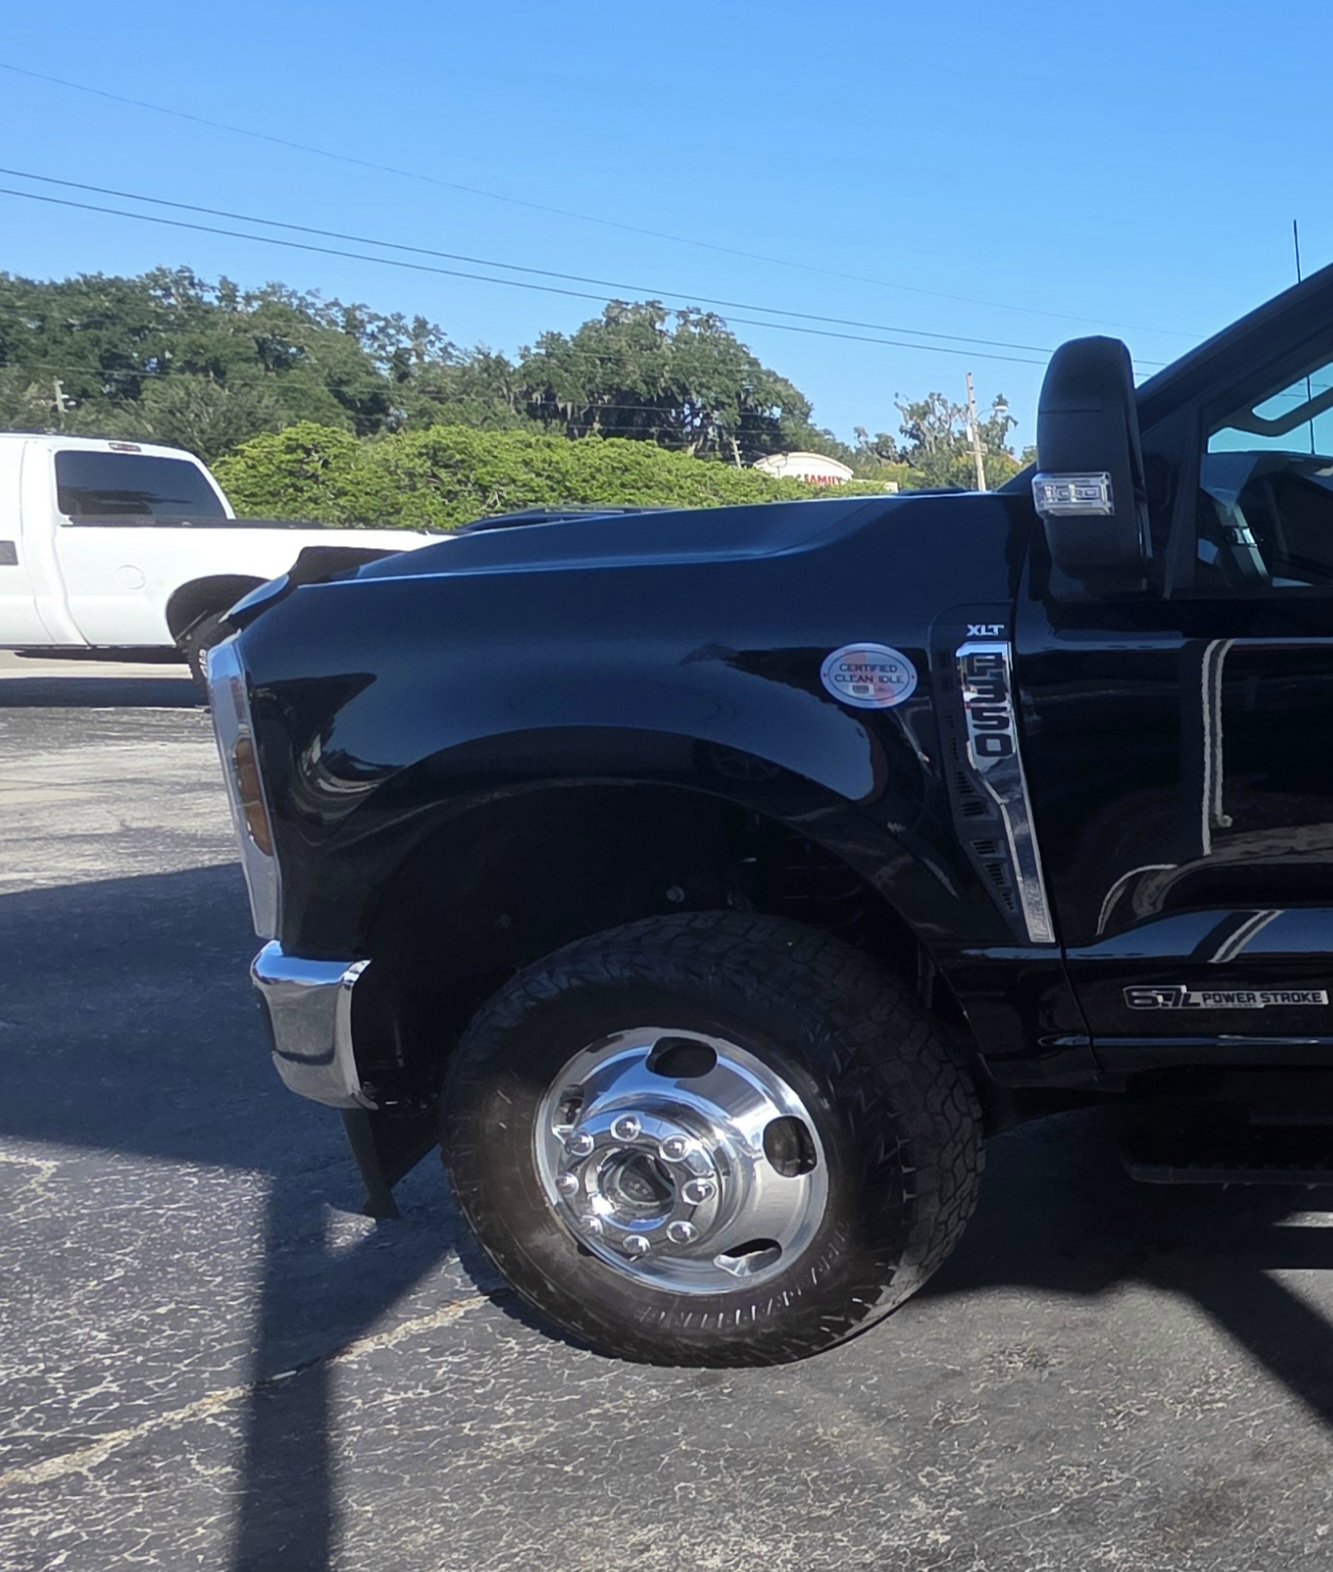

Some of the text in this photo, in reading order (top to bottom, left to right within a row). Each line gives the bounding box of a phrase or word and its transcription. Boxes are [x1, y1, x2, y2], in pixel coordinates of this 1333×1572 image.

[966, 624, 1005, 636] XLT
[839, 663, 898, 673] CERTIFIED
[834, 674, 904, 683] CLEAN IDLE
[1202, 992, 1257, 1003] POWER
[1260, 992, 1323, 1003] STROKE
